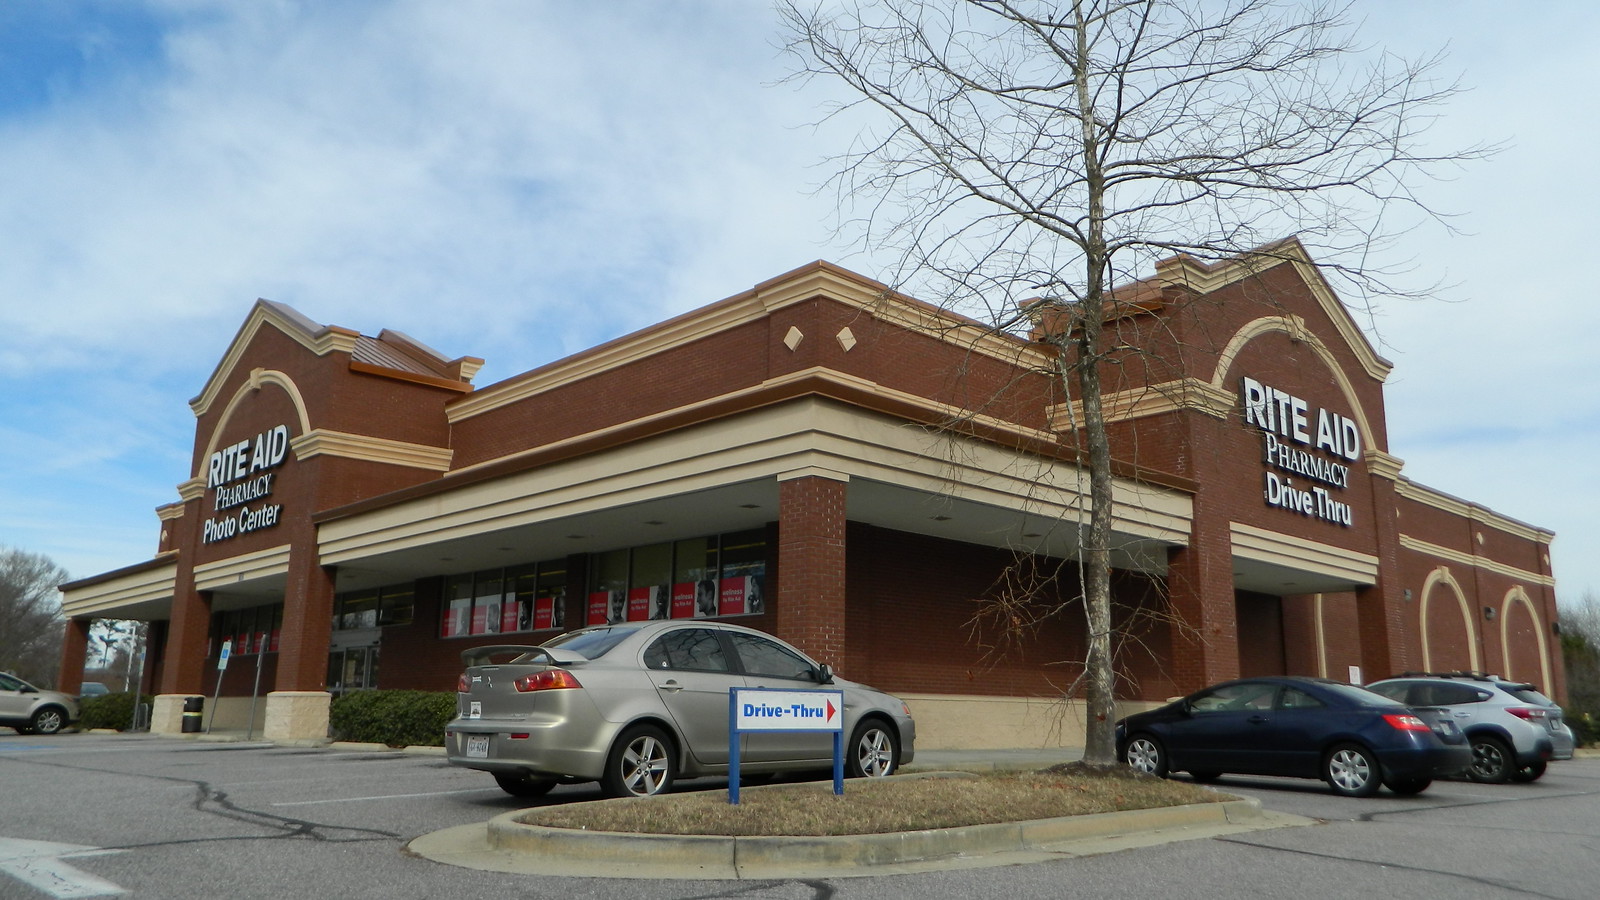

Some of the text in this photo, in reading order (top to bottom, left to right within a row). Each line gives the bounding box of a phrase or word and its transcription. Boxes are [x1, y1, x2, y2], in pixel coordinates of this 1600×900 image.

[1243, 376, 1361, 461] RITE AID
[207, 424, 288, 489] RITE AID
[1264, 431, 1349, 489] PHARMACY
[214, 473, 272, 511] PHARMACY
[1266, 471, 1352, 526] Drive Thru
[202, 504, 280, 544] Photo Center
[743, 703, 824, 718] Drive-Thru
